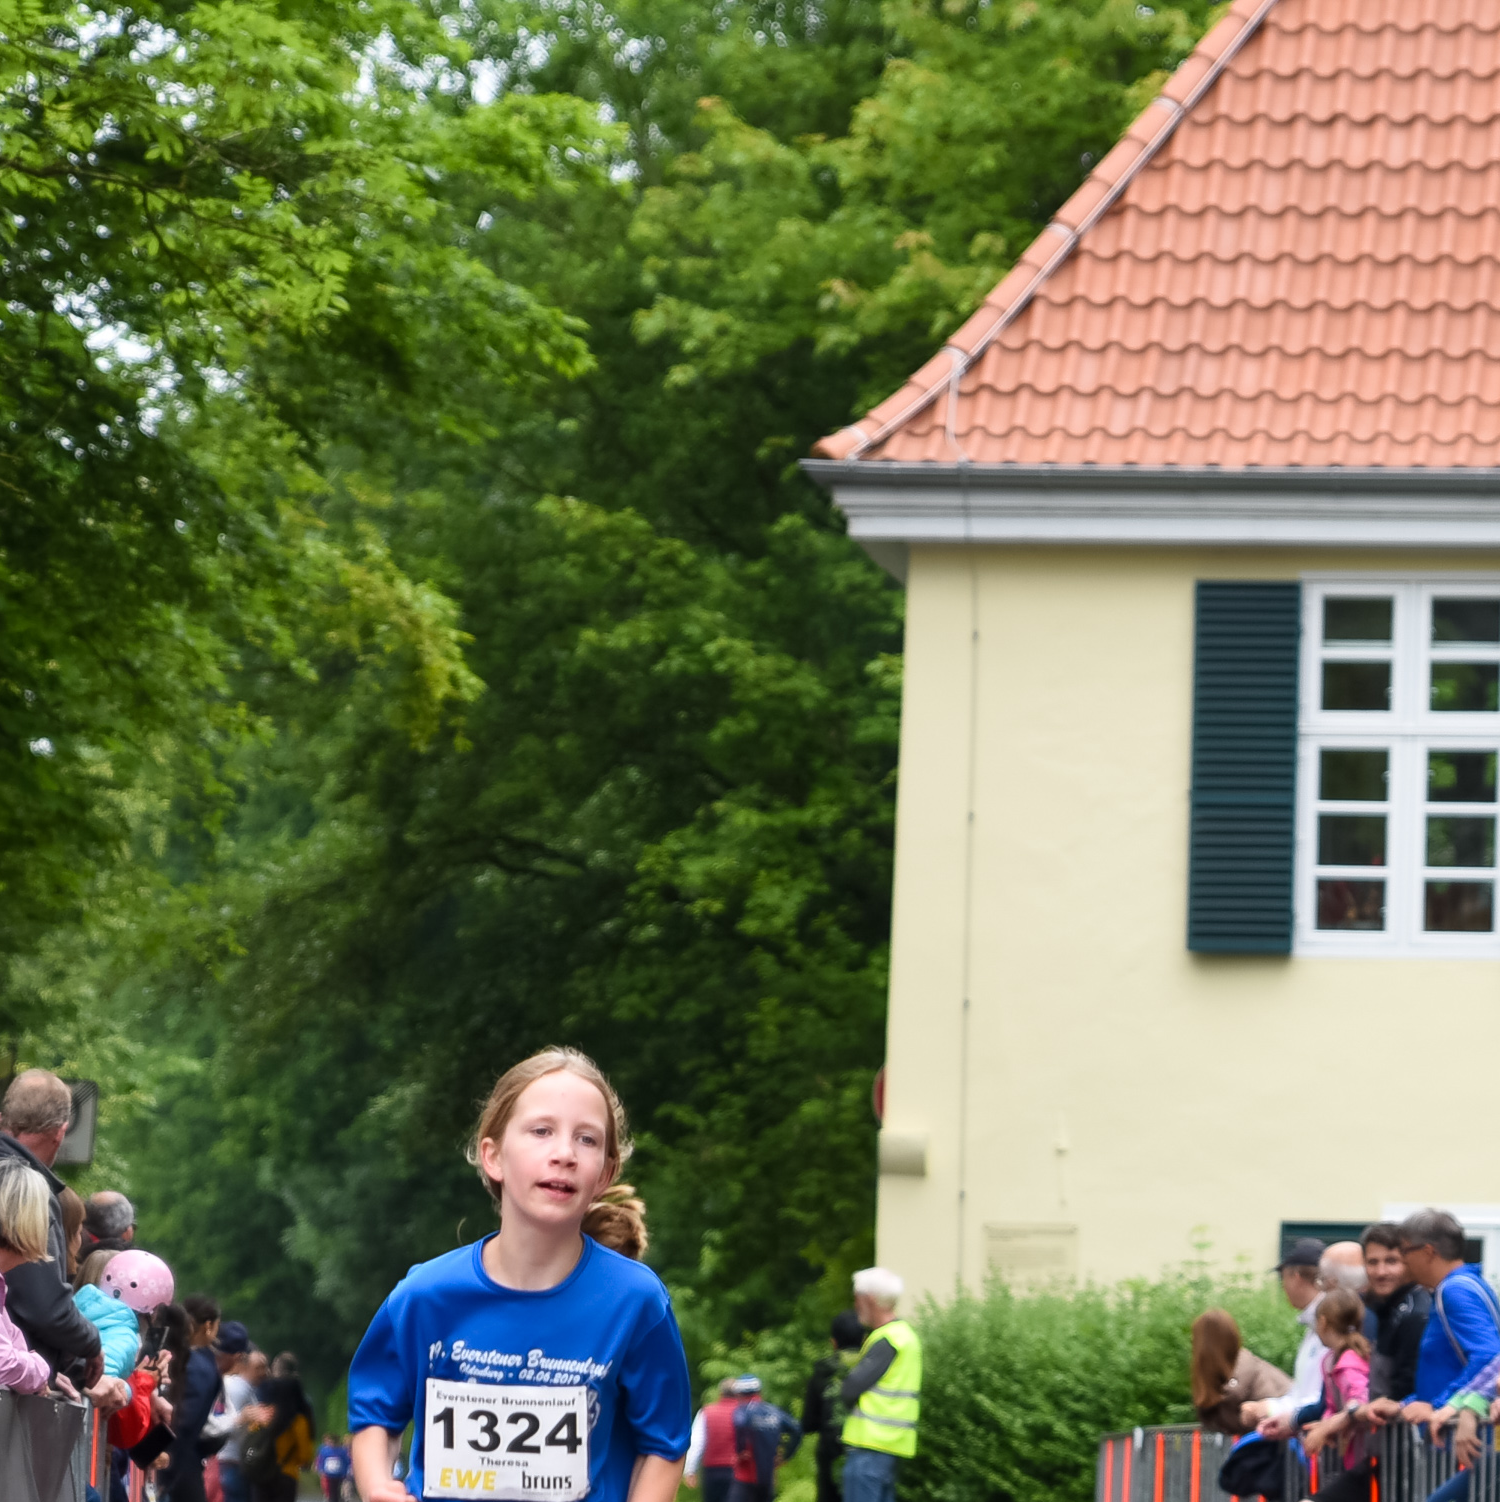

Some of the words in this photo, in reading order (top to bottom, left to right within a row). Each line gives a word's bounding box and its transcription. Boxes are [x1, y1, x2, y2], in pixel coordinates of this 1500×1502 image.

[451, 1340, 523, 1367] Everstener
[458, 1361, 504, 1382] Oldenburg
[435, 1391, 498, 1406] Everstener
[501, 1396, 577, 1408] Brunnenlauf
[432, 1406, 583, 1455] 1324
[478, 1456, 530, 1468] Theresa
[439, 1467, 498, 1491] EWE
[521, 1470, 573, 1491] bruns
